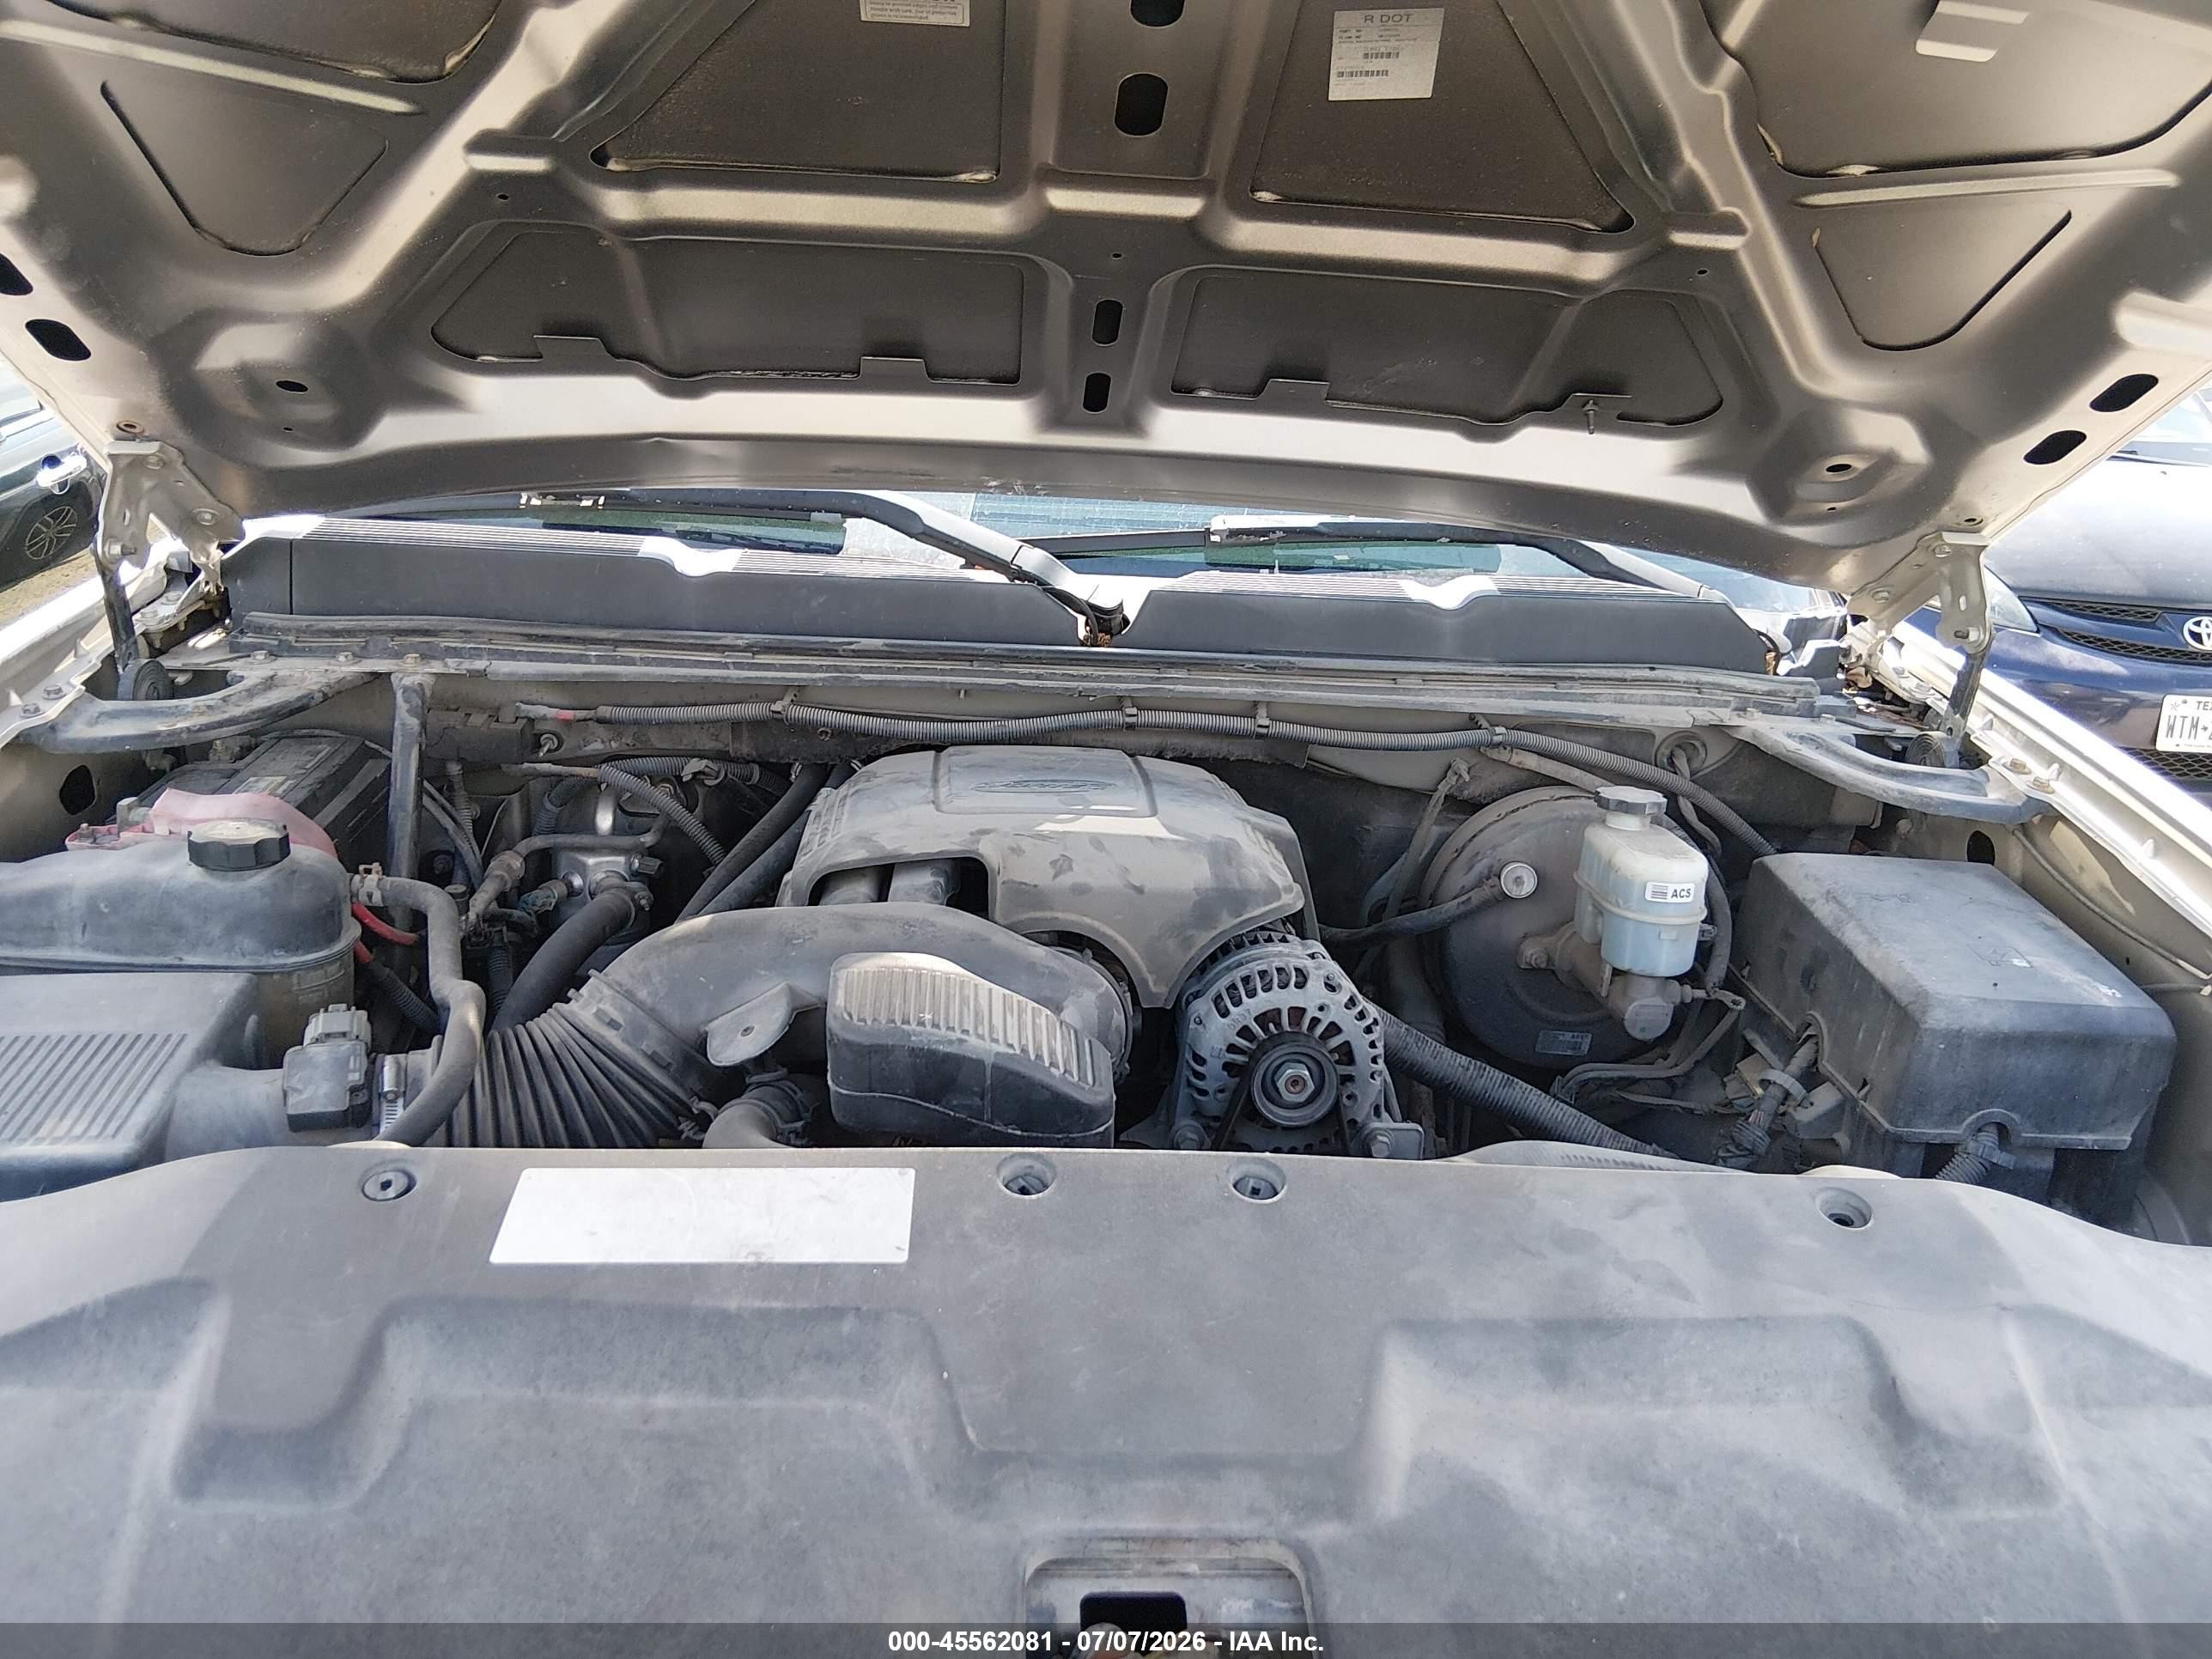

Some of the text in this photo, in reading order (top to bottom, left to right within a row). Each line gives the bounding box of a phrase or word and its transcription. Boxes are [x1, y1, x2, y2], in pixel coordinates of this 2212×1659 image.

[1364, 13, 1413, 23] R DOT
[2197, 701, 2212, 711] TE
[1671, 888, 1692, 898] ACS
